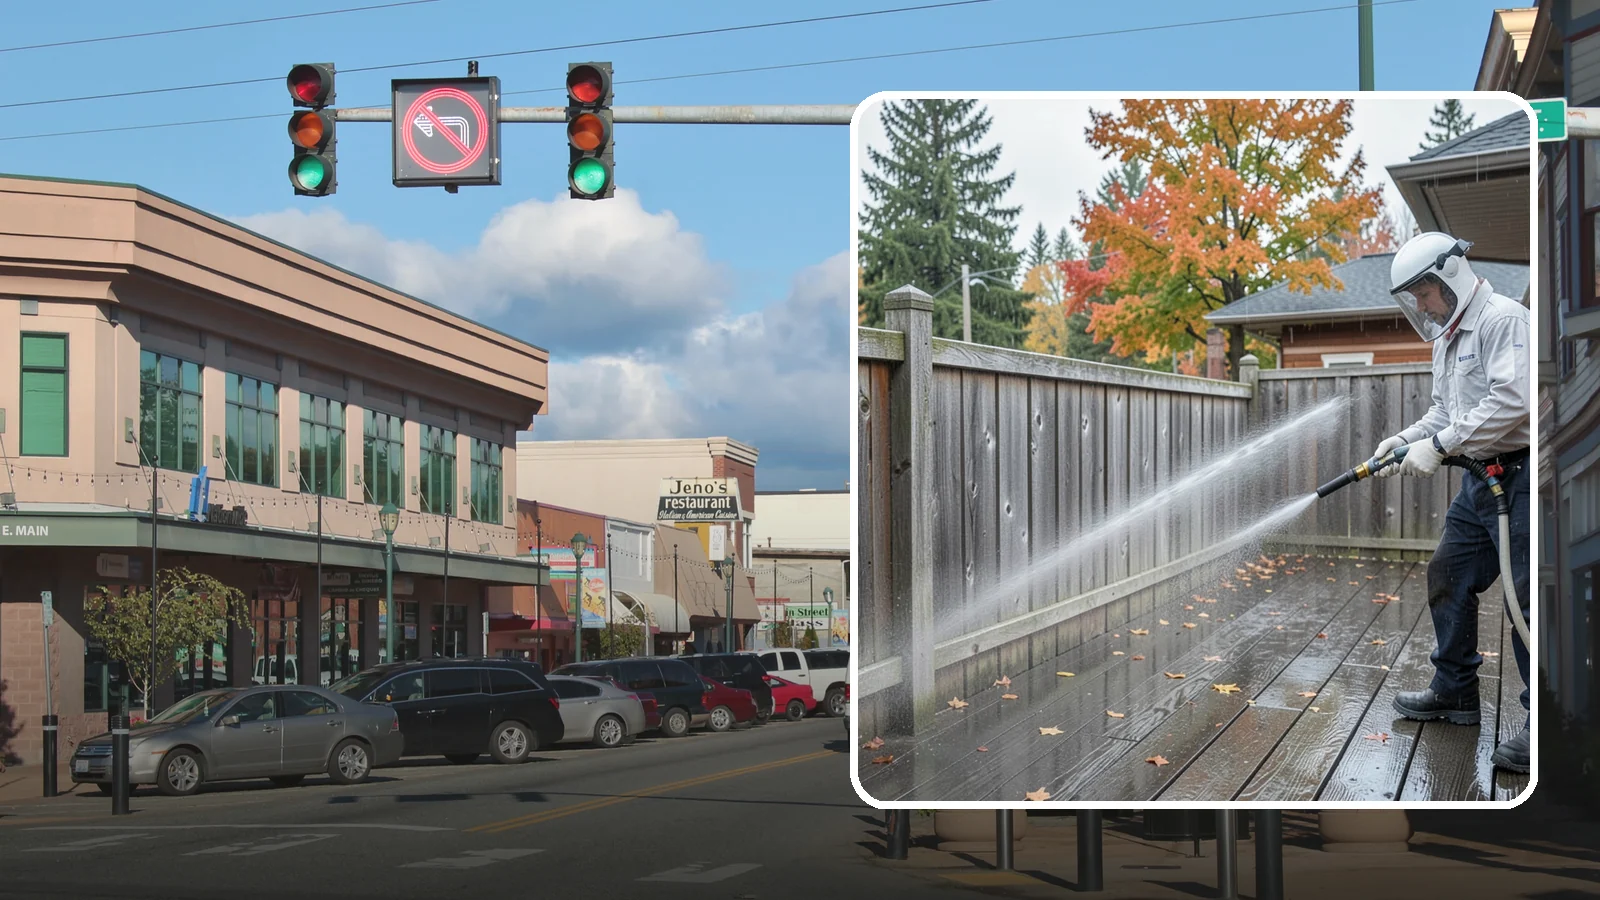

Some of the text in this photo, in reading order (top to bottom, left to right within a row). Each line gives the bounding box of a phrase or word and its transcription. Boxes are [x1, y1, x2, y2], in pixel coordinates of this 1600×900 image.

[669, 480, 727, 494] Jeno's
[665, 496, 731, 509] restaurant
[686, 509, 714, 519] American
[715, 509, 738, 519] Cuisine
[2, 525, 49, 536] E. MAIN
[797, 607, 828, 616] Street
